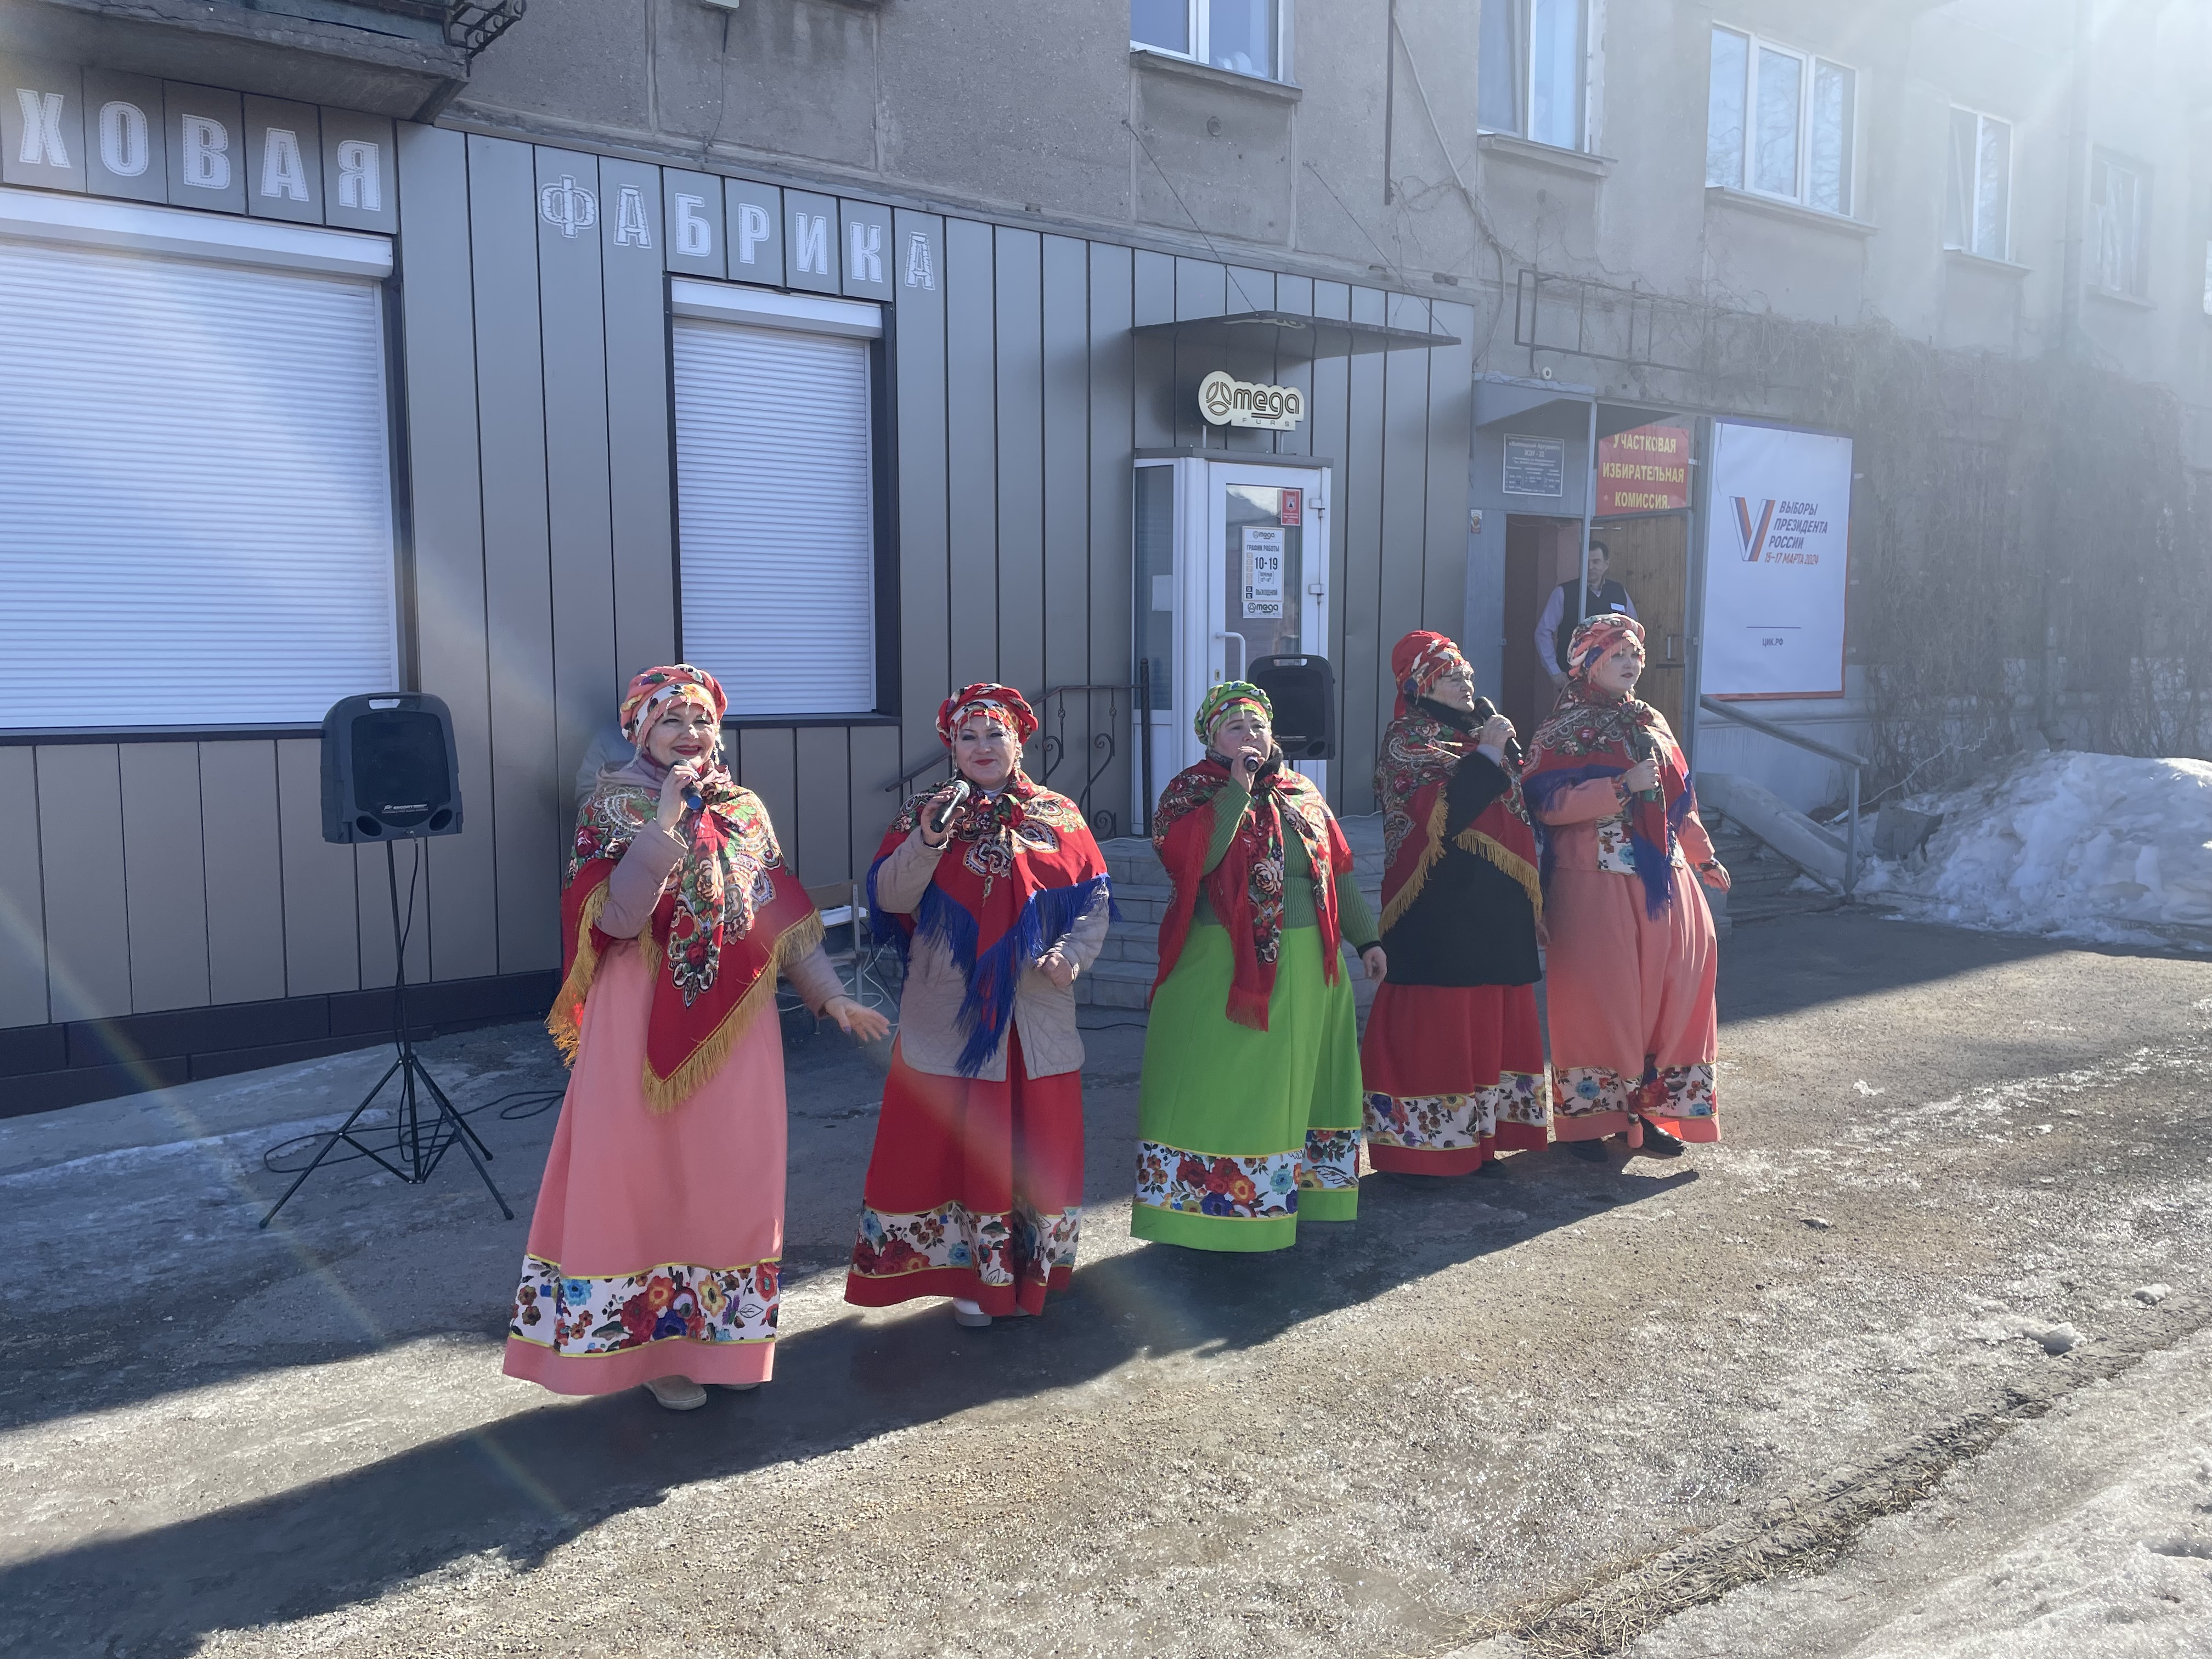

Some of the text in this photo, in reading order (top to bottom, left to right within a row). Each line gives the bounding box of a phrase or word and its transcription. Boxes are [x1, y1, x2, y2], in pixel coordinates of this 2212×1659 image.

[16, 88, 935, 291] ХОВАЯ ФАБРИКА
[1242, 417, 1289, 427] FURS
[1613, 433, 1677, 453] УЧАСТКОВАЯ
[1602, 462, 1685, 483] ИЗБИРАТЕЛЬНАЯ
[1779, 500, 1819, 516] ВЫБОРЫ
[1773, 518, 1828, 534] ПРЕЗИДЕНТА
[1768, 535, 1804, 549] РОССИИ
[1782, 552, 1804, 565] МАРТА
[1804, 554, 1819, 565] 2024
